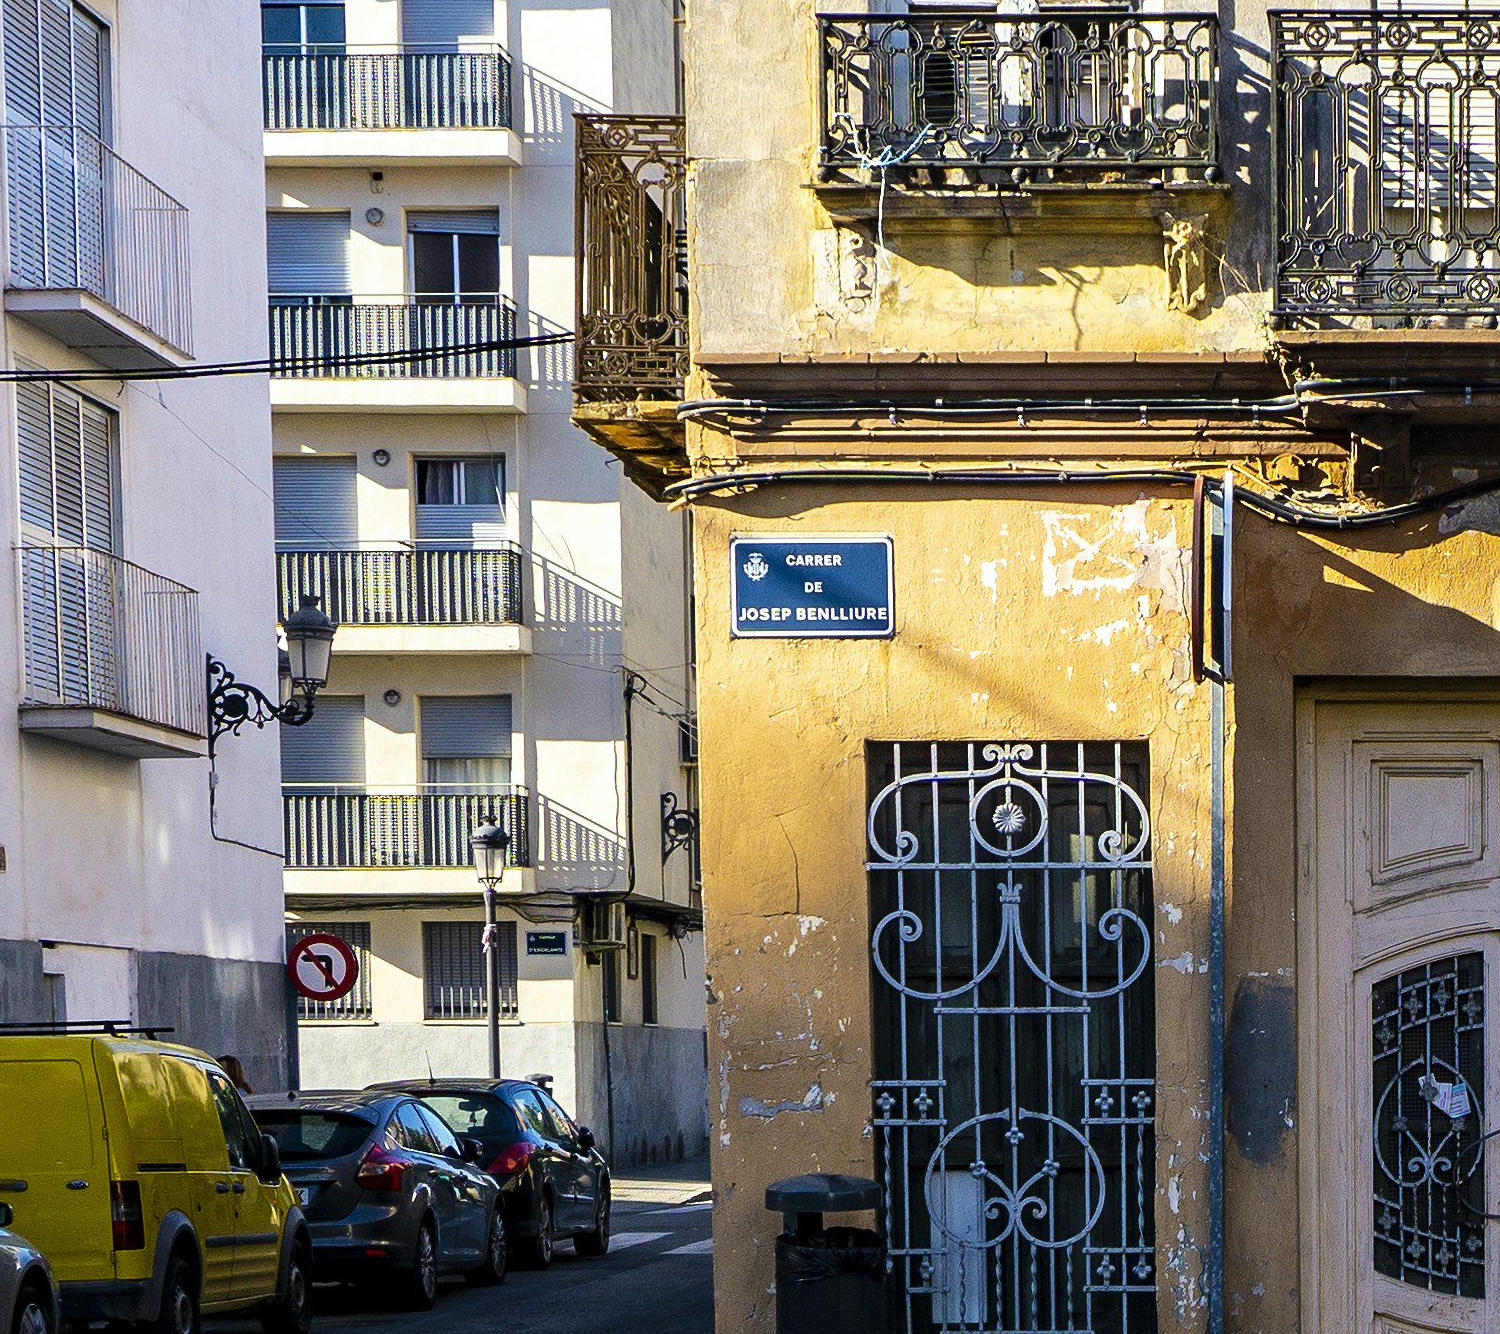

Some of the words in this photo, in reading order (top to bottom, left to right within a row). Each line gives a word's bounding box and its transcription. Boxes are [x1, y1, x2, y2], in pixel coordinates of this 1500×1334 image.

[785, 554, 843, 567] CARRER
[804, 581, 823, 593] DE
[739, 607, 792, 622] JOSEP
[796, 607, 888, 621] BENLLIURE
